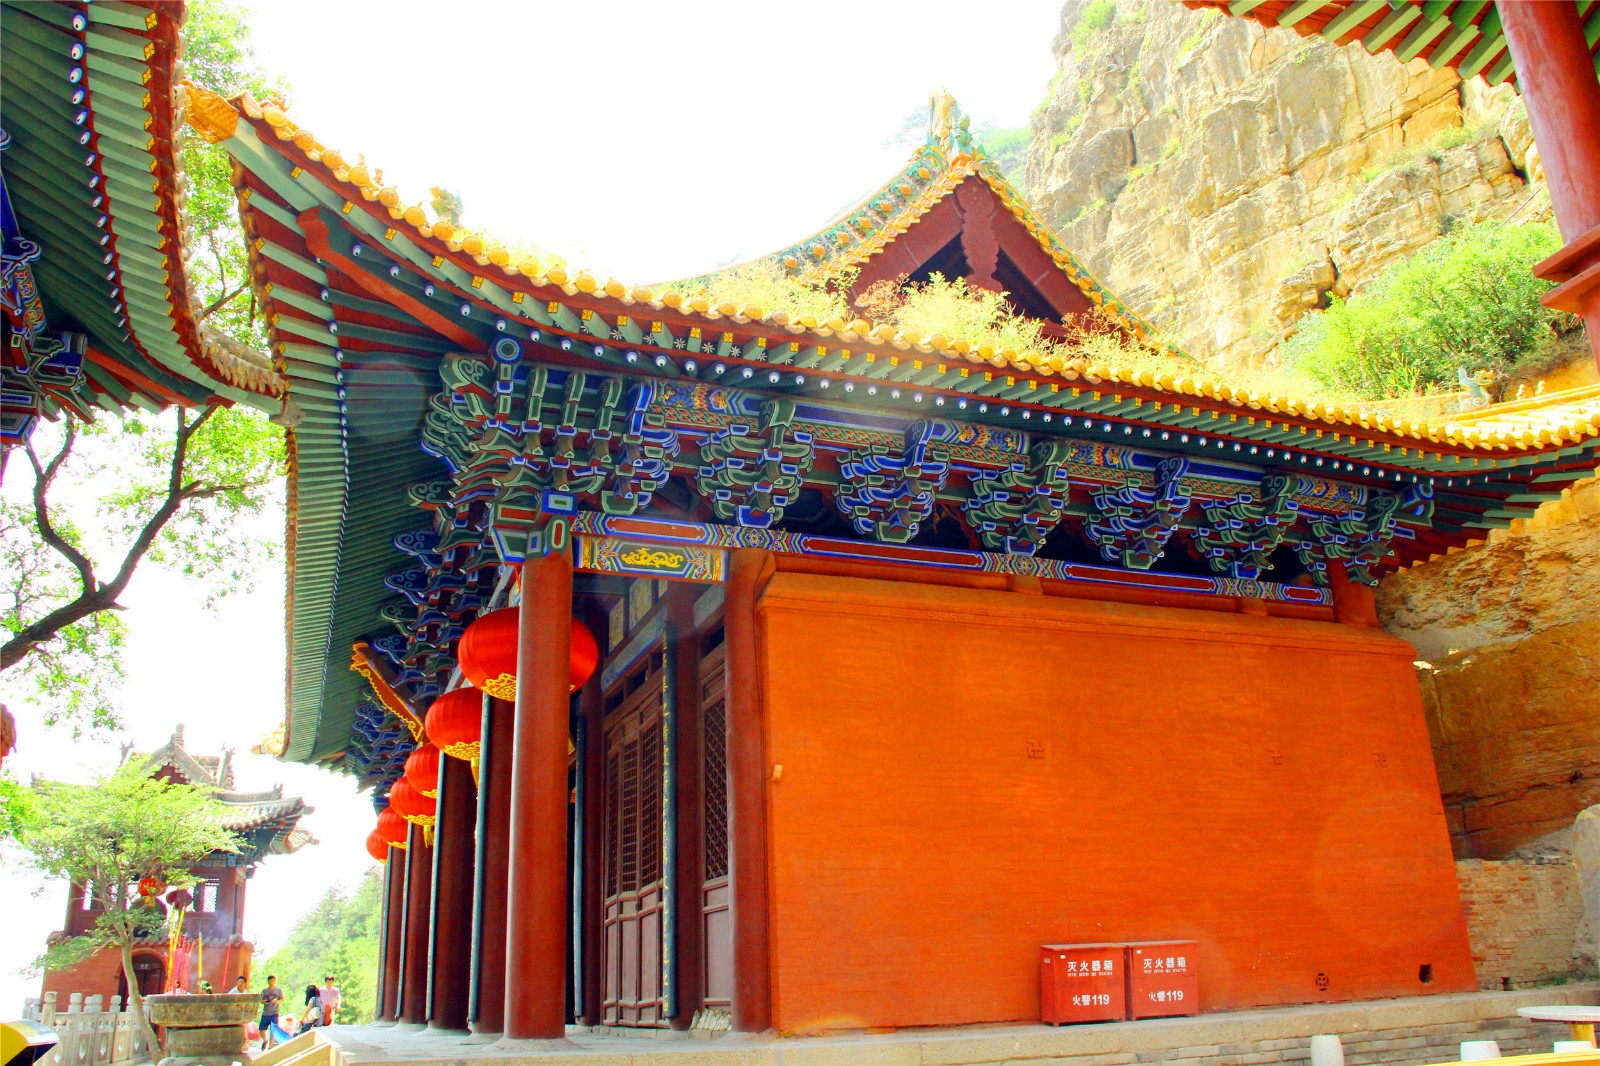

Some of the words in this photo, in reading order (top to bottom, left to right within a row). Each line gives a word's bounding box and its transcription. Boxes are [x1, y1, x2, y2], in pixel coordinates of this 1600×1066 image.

[1067, 959, 1113, 972] 灭火器箱
[1143, 956, 1186, 969] 灭火器箱
[1072, 993, 1110, 1006] 火警119
[1148, 990, 1184, 1002] 火警119
